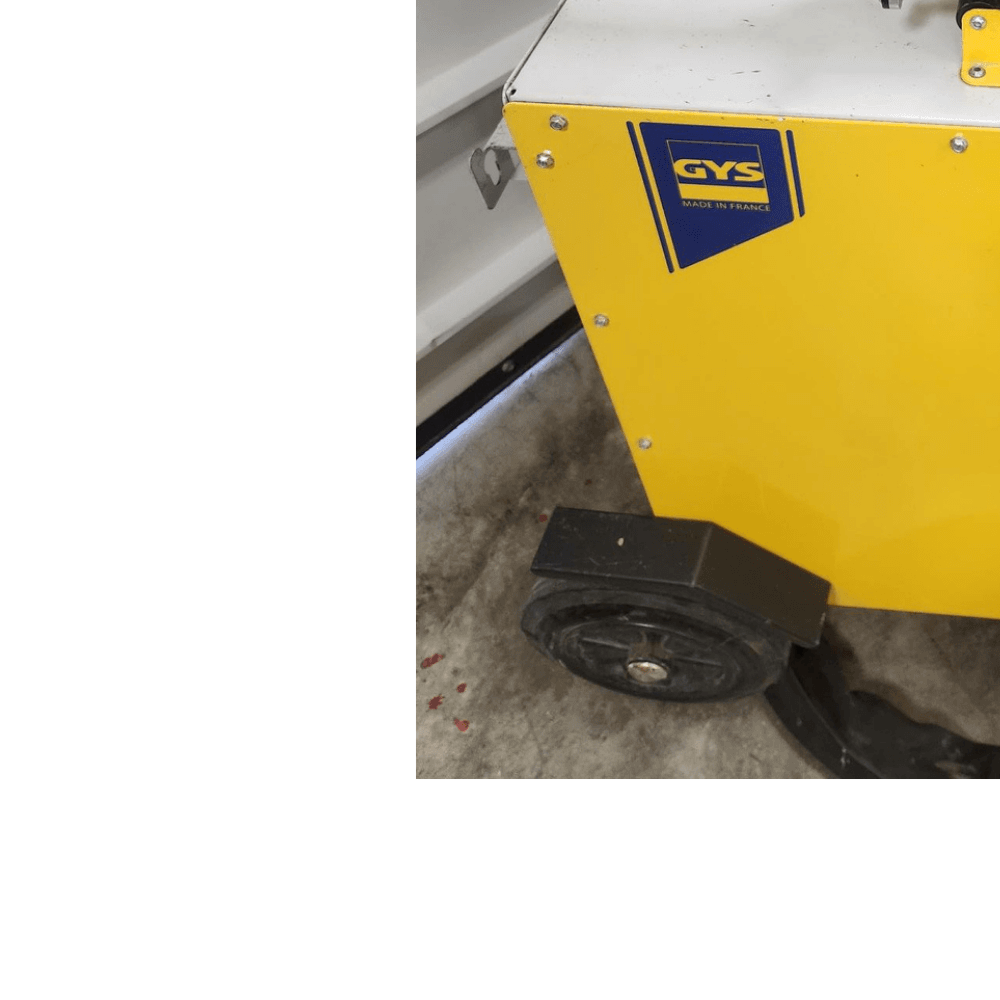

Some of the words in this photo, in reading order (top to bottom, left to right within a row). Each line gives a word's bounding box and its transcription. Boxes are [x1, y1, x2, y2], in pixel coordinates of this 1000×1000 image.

[674, 158, 765, 182] GYS
[682, 200, 713, 208] MADE
[730, 203, 771, 212] FRANCE
